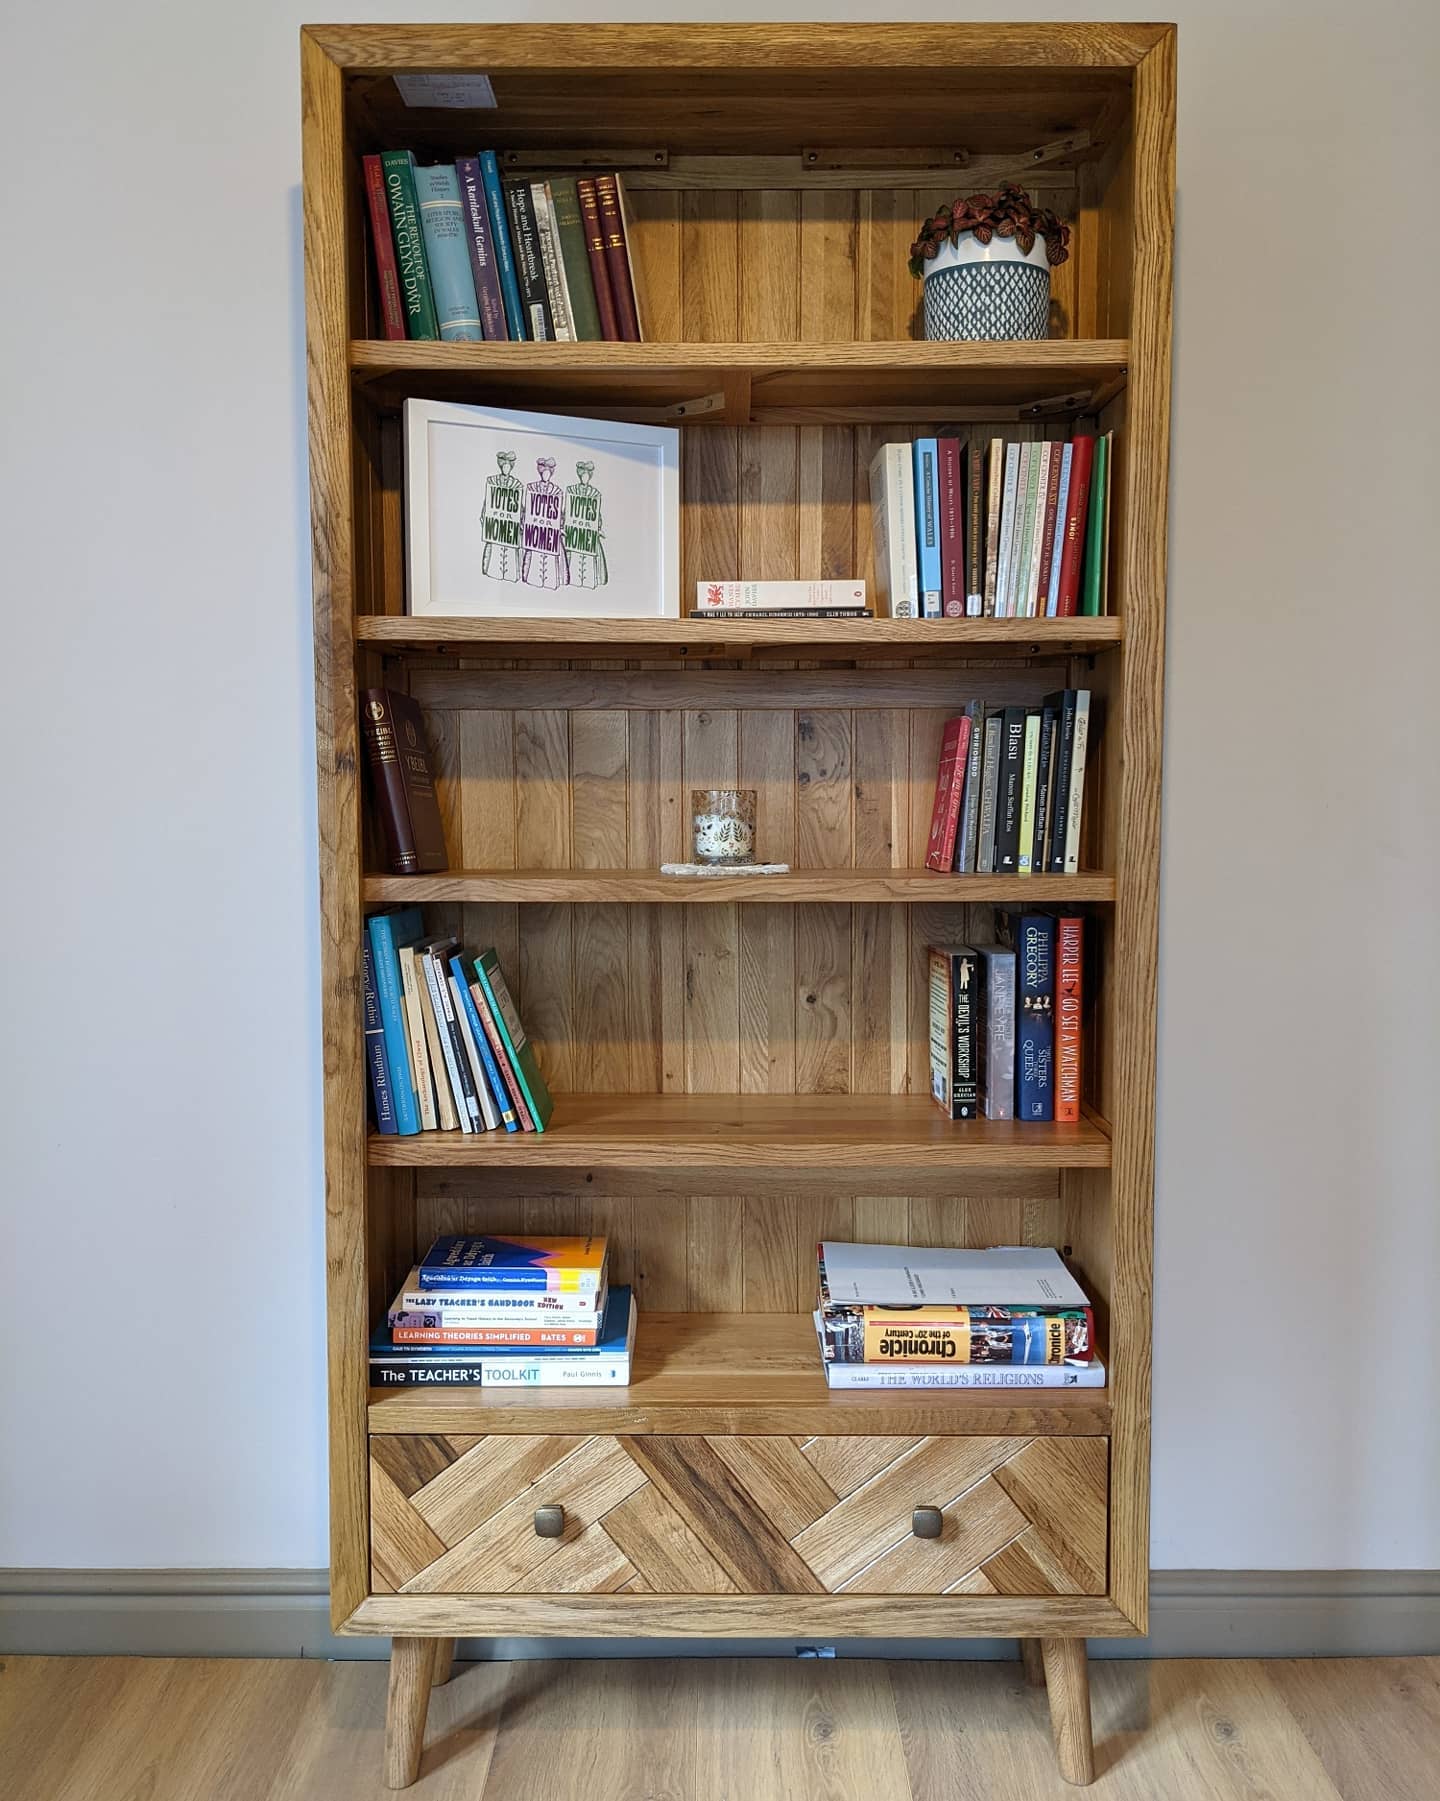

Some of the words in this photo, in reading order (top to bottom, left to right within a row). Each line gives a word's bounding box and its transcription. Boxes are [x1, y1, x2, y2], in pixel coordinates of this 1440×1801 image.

[384, 157, 409, 168] DAVIES
[464, 173, 474, 183] A
[386, 172, 408, 229] OWAIN
[465, 183, 484, 234] Rattleskull
[514, 187, 527, 213] Hope
[404, 203, 416, 225] THE
[520, 213, 530, 230] and
[395, 230, 415, 275] GLYN
[407, 225, 423, 265] REVOLT
[473, 234, 490, 267] Genius
[523, 232, 539, 280] Heartbreak
[413, 265, 425, 281] OF
[490, 486, 519, 513] VOTES
[530, 492, 559, 520] VOTES
[570, 495, 597, 521] VOTES
[493, 511, 512, 519] FOR
[534, 519, 552, 527] FOR
[573, 519, 591, 527] FOR
[1068, 516, 1077, 539] JONES
[485, 516, 520, 545] WOMEN
[525, 523, 559, 553] WOMEN
[565, 525, 597, 553] WOMEN
[926, 520, 934, 545] WALES
[1064, 707, 1073, 720] John
[1008, 723, 1022, 760] Blasu
[1063, 721, 1071, 739] Davies
[971, 727, 980, 777] GWIRIONEDD
[1007, 773, 1015, 795] Manon
[1038, 783, 1047, 806] Manon
[981, 788, 993, 834] CHWALFA
[1006, 796, 1014, 818] Steffan
[1026, 927, 1038, 988] GREGORY
[1037, 932, 1049, 983] PHILIPPA
[1062, 926, 1080, 965] HARPER
[993, 969, 1006, 1003] JANE
[1062, 968, 1078, 984] LEE
[365, 993, 377, 1025] Ruthin
[1062, 998, 1079, 1012] GO
[957, 1004, 970, 1034] DEVIL'S
[992, 1007, 1005, 1041] EYRE
[1061, 1015, 1078, 1031] SET
[373, 1044, 386, 1088] Rhuthun
[957, 1035, 970, 1079] WORKSHOP
[1024, 1039, 1034, 1081] QUEENS
[1038, 1049, 1047, 1088] SISTERS
[1060, 1045, 1078, 1102] WATCHMAN
[378, 1090, 391, 1121] Hanes
[415, 1297, 436, 1306] LAZY
[439, 1298, 485, 1307] TEACHER'S
[488, 1299, 535, 1307] HANDBOOK
[537, 1302, 564, 1310] EDITION
[398, 1332, 441, 1340] LEARNING
[443, 1332, 484, 1340] THEORIES
[486, 1332, 530, 1341] SIMPLIFIED
[541, 1334, 566, 1342] BATES
[885, 1328, 914, 1338] Century
[929, 1330, 941, 1338] the
[942, 1330, 951, 1338] of
[879, 1340, 956, 1358] Chronicle
[381, 1370, 405, 1382] The
[409, 1368, 481, 1381] TEACHER'S
[484, 1369, 540, 1381] TOOLKIT
[880, 1375, 907, 1385] THE
[911, 1375, 969, 1385] WORLD'S
[973, 1373, 1044, 1385] RELIGIONS
